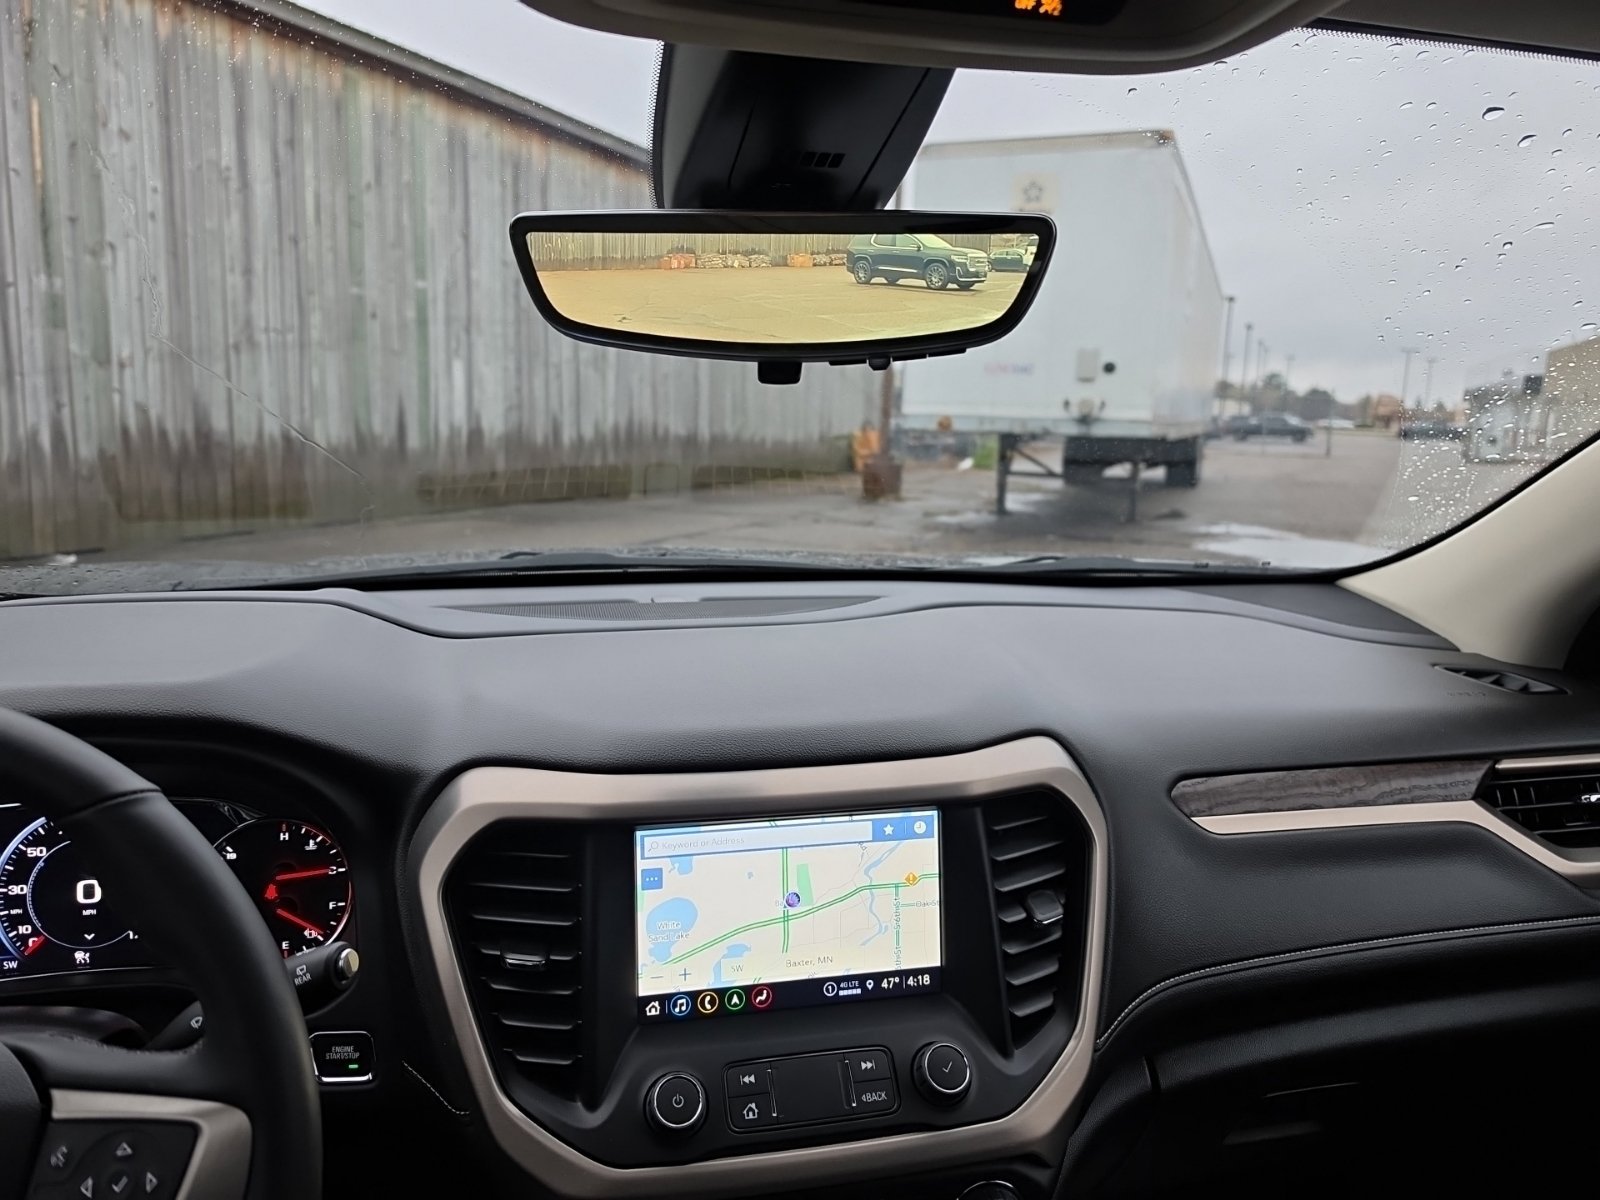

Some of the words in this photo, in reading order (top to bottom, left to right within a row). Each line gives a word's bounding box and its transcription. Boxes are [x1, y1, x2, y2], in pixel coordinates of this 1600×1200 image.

[280, 832, 289, 841] H
[661, 839, 698, 851] Keyword
[711, 837, 745, 846] Address
[26, 846, 47, 858] 50
[7, 884, 28, 895] 30
[76, 879, 102, 904] 0
[328, 901, 337, 910] F
[82, 908, 97, 916] MPH
[17, 924, 32, 934] 10
[656, 921, 681, 930] White
[648, 932, 669, 942] Sand
[281, 940, 290, 950] E
[817, 955, 833, 964] MN
[3, 960, 18, 970] SW
[731, 964, 744, 973] SW
[294, 973, 312, 986] REAR
[848, 980, 859, 988] LTE
[907, 974, 931, 987] 4:18
[331, 1045, 355, 1053] ENGINE
[866, 1090, 888, 1103] BACK
